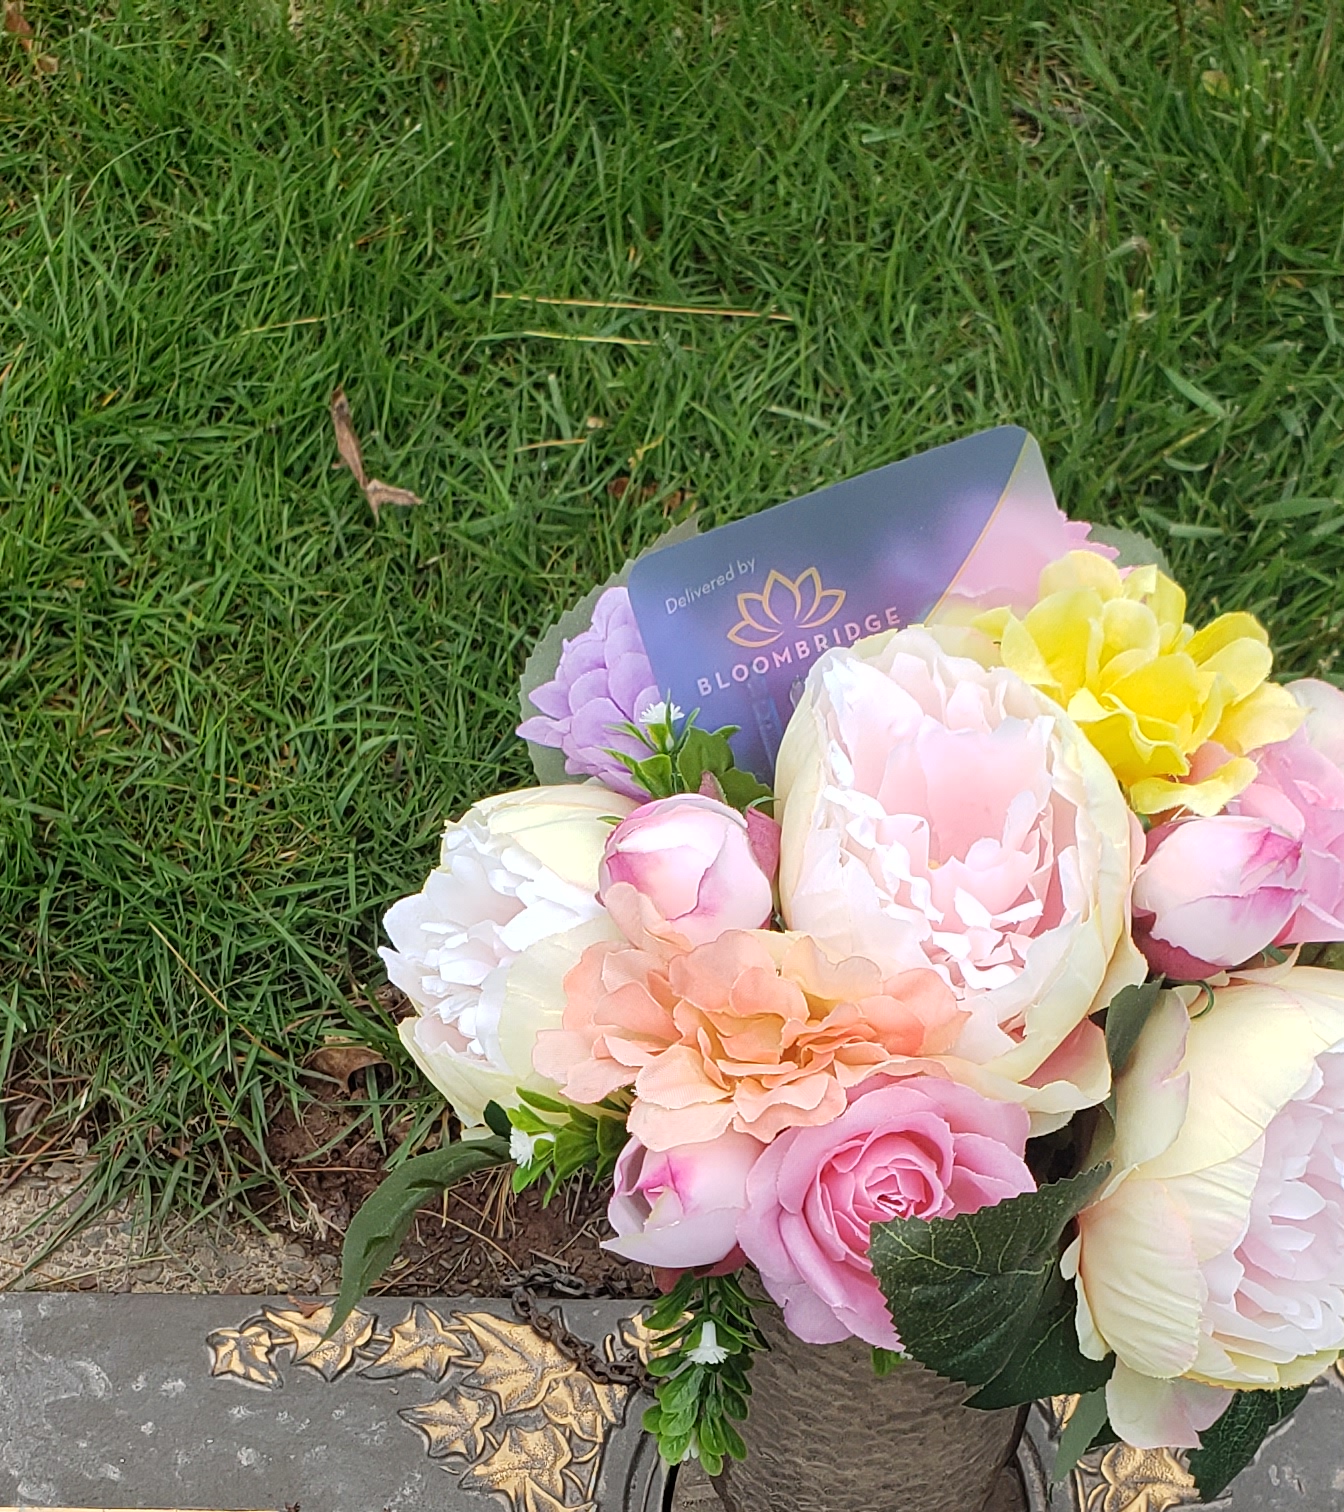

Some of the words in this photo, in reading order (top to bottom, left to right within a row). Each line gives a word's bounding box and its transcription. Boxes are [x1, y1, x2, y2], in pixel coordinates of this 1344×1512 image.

[665, 564, 735, 615] Delivered
[737, 557, 757, 577] by
[697, 606, 902, 698] BLOOMBRIDGE
